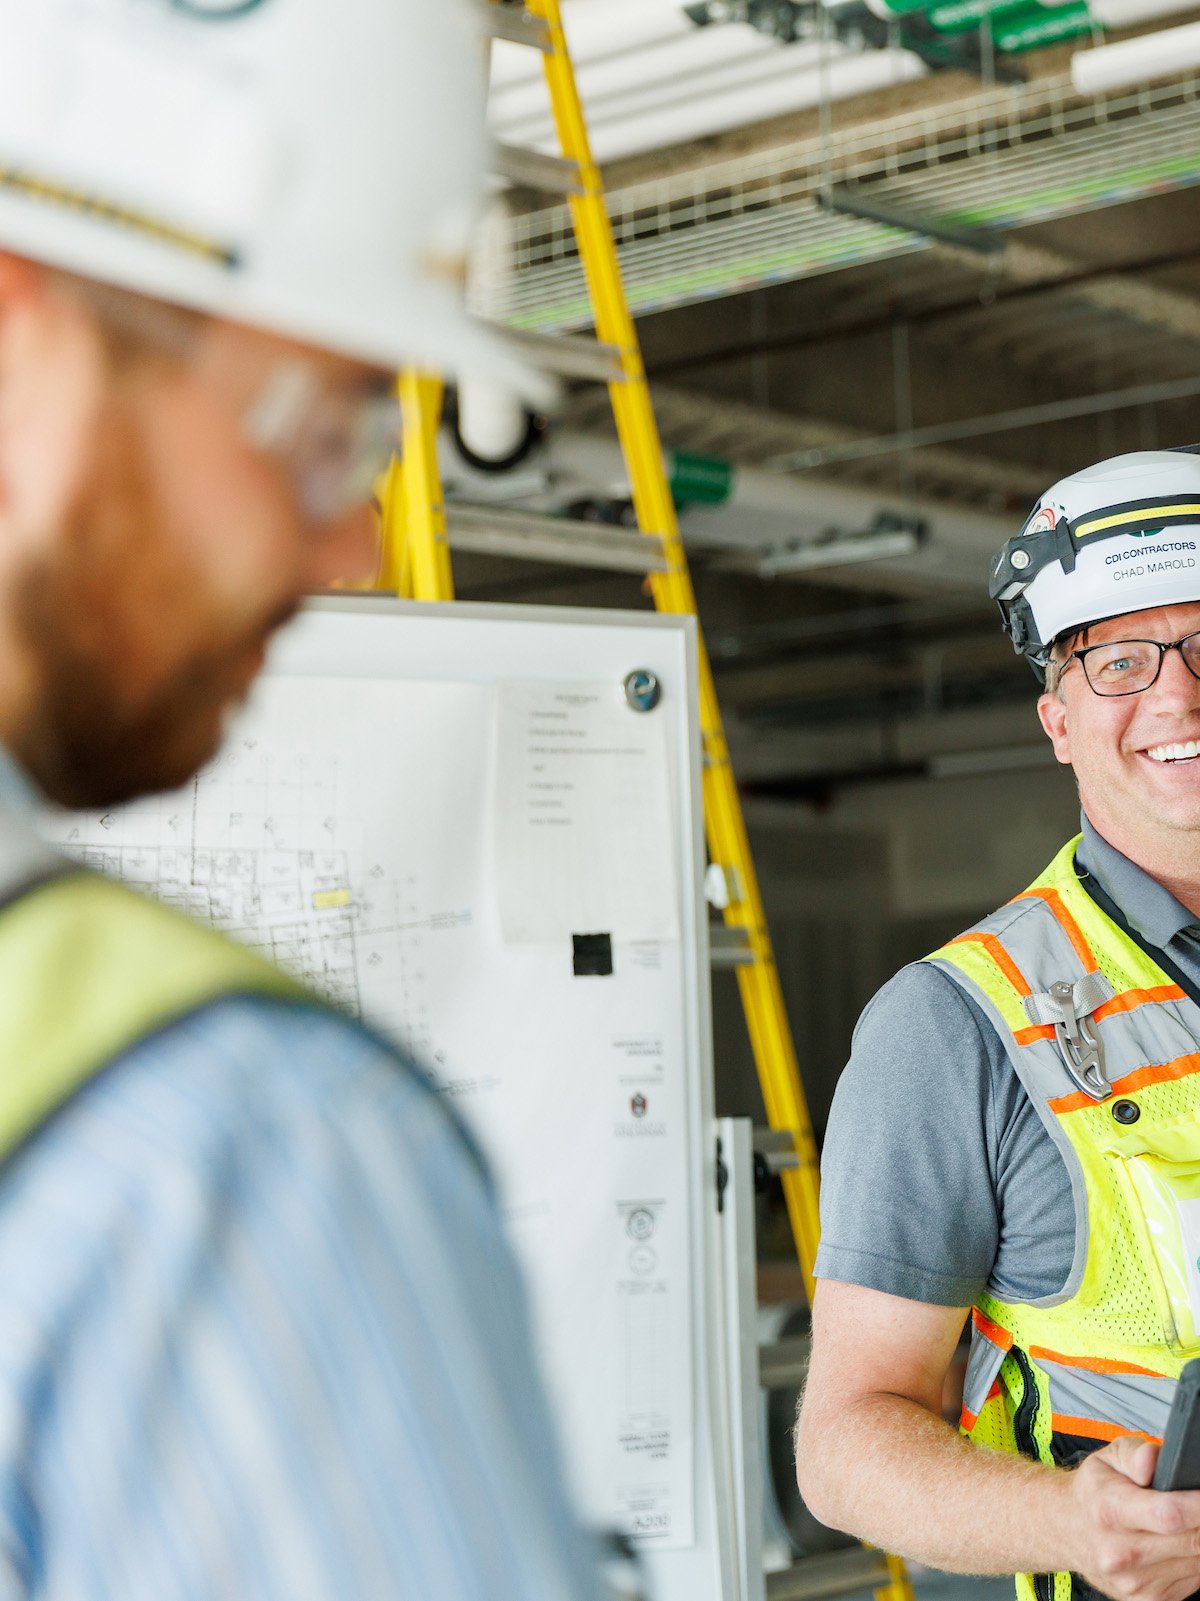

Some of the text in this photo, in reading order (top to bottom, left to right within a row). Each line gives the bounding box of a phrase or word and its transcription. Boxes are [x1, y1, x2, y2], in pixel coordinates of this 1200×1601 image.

[1104, 541, 1197, 565] CDI CONTRACTORS
[1113, 558, 1196, 581] CHAD MAROLD
